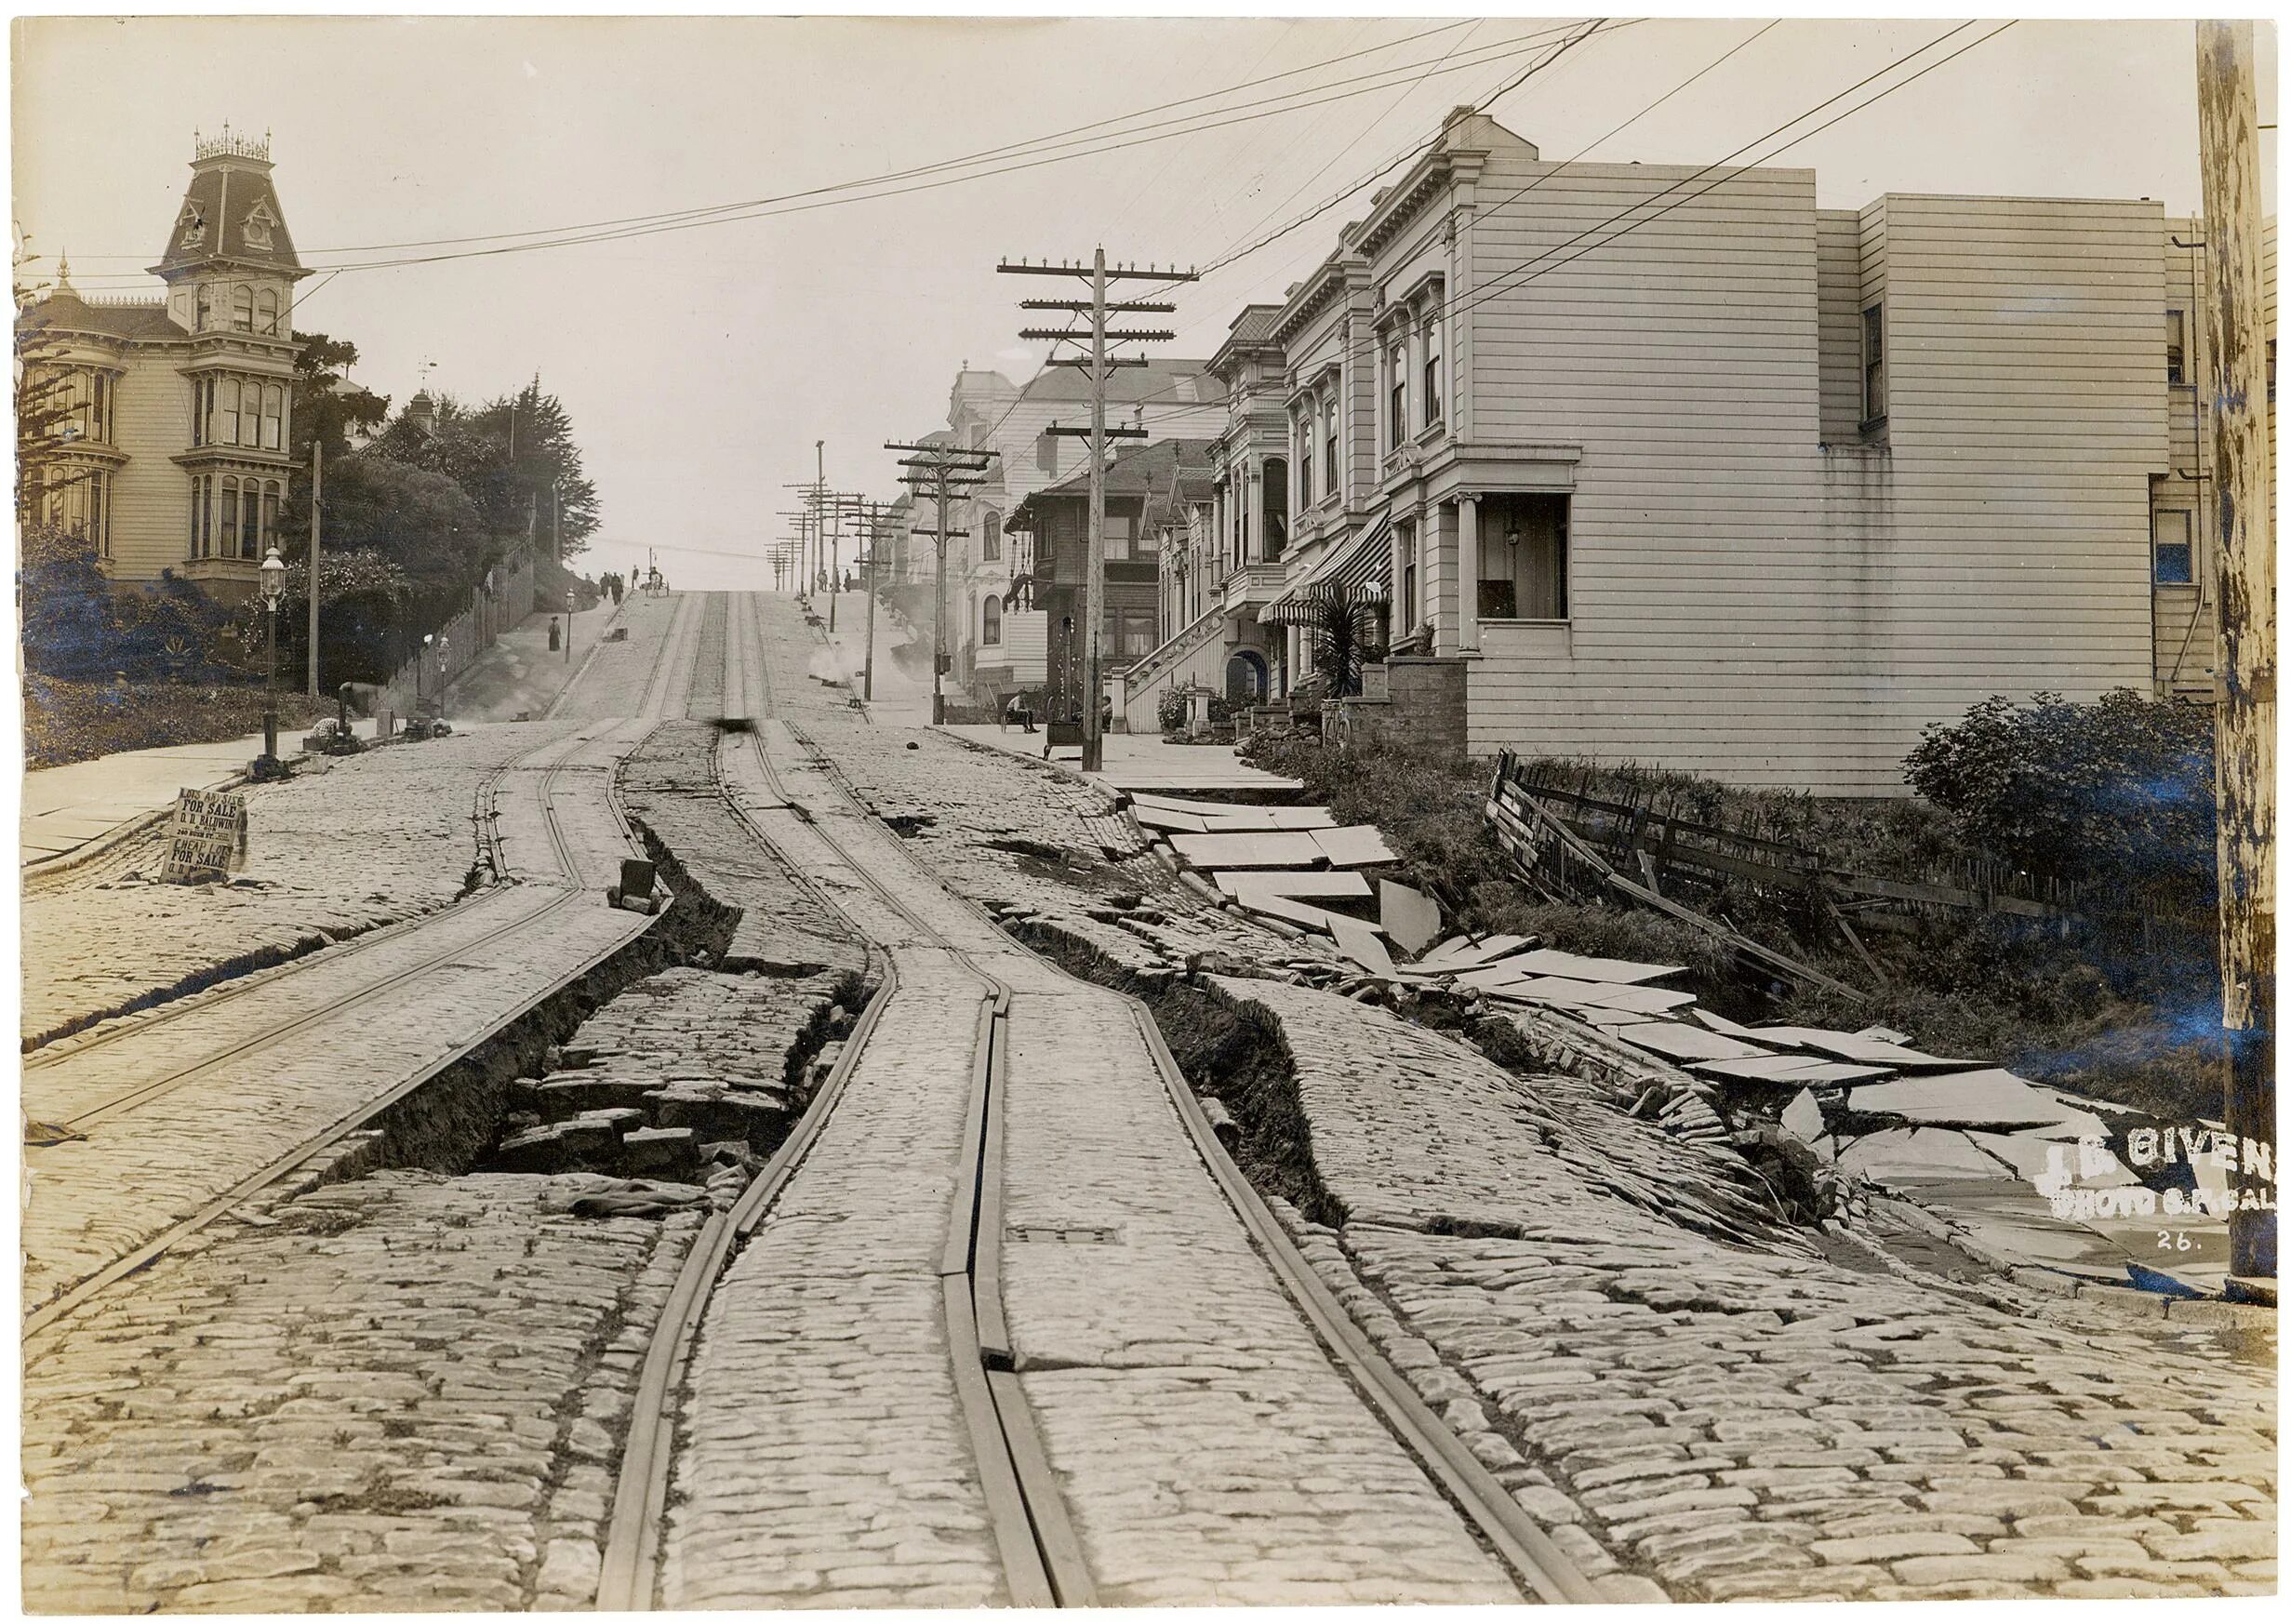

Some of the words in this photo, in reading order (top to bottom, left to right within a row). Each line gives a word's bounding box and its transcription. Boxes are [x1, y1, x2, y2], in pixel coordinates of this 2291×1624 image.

[182, 799, 204, 813] FOR
[206, 803, 236, 819] SALE
[199, 815, 234, 831] BALDWIN
[174, 838, 206, 853] CHEAP
[209, 844, 233, 857] LOTS
[171, 849, 193, 863] FOR
[196, 852, 226, 869] SALE
